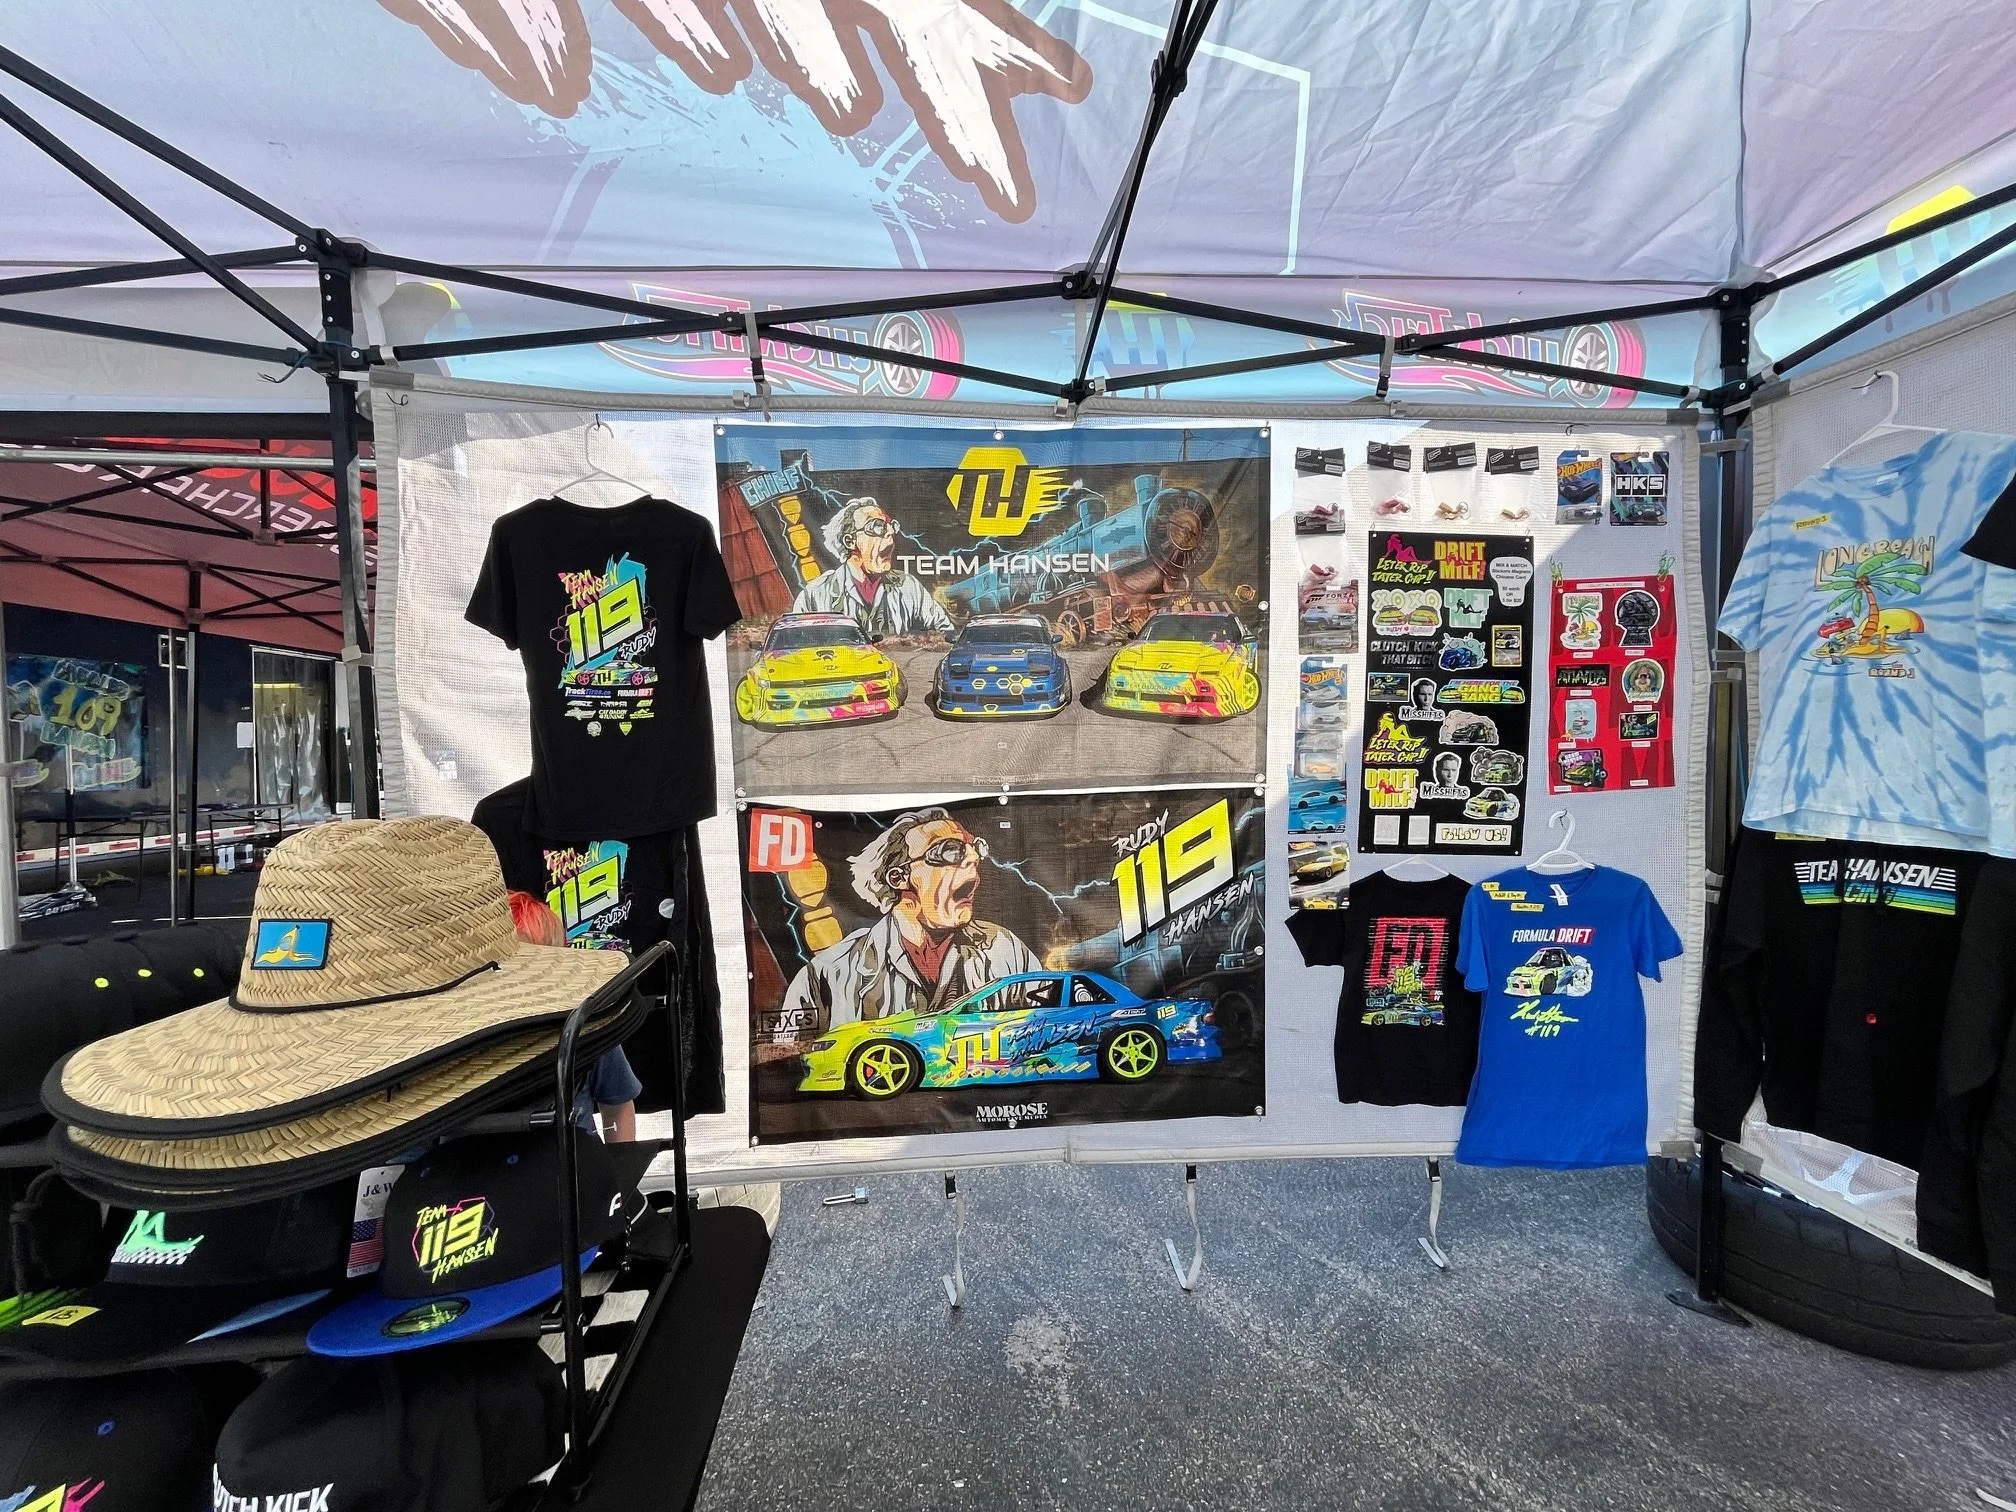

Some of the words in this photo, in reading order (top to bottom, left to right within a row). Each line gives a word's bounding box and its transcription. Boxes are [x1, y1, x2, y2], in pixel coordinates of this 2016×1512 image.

[740, 463, 800, 506] CHIEF
[1616, 476, 1664, 491] HKS
[1435, 541, 1486, 561] DRIFT
[897, 555, 979, 575] TEAM
[988, 553, 1110, 575] HANSEN
[1440, 561, 1482, 580] MILF
[1814, 543, 1874, 588] LONG
[564, 569, 592, 594] TEAM
[572, 566, 619, 609] HANSEN
[1371, 571, 1404, 584] TATER
[1374, 591, 1441, 608] XOXO
[1445, 588, 1493, 607] DRIFT
[565, 577, 645, 667] 119
[618, 626, 657, 660] RUDY
[1370, 641, 1410, 652] CLUTCH
[1413, 641, 1439, 652] KICK
[1381, 654, 1407, 665] THAT
[1458, 684, 1501, 694] GANG
[1365, 750, 1397, 762] TATER
[1365, 769, 1418, 788] DRIFT
[1369, 788, 1412, 808] MILF
[757, 813, 806, 867] FD
[1111, 808, 1169, 858] RUDY
[544, 847, 576, 871] TEAM
[551, 841, 601, 886] HANSEN
[1111, 797, 1235, 944] 119
[1807, 859, 1840, 884] TEA
[545, 855, 620, 931] 119
[593, 900, 632, 930] RUDY
[1163, 872, 1255, 946] HANSEN
[1511, 929, 1556, 943] FORMULA
[1556, 928, 1592, 944] DRIFT
[1156, 1004, 1178, 1020] 119
[1524, 1025, 1561, 1038] #119
[975, 1102, 1048, 1119] MOROSE
[363, 1182, 395, 1198] J&W
[416, 1205, 447, 1228] TEAM
[418, 1201, 487, 1268] 119
[431, 1227, 500, 1284] HANSEN
